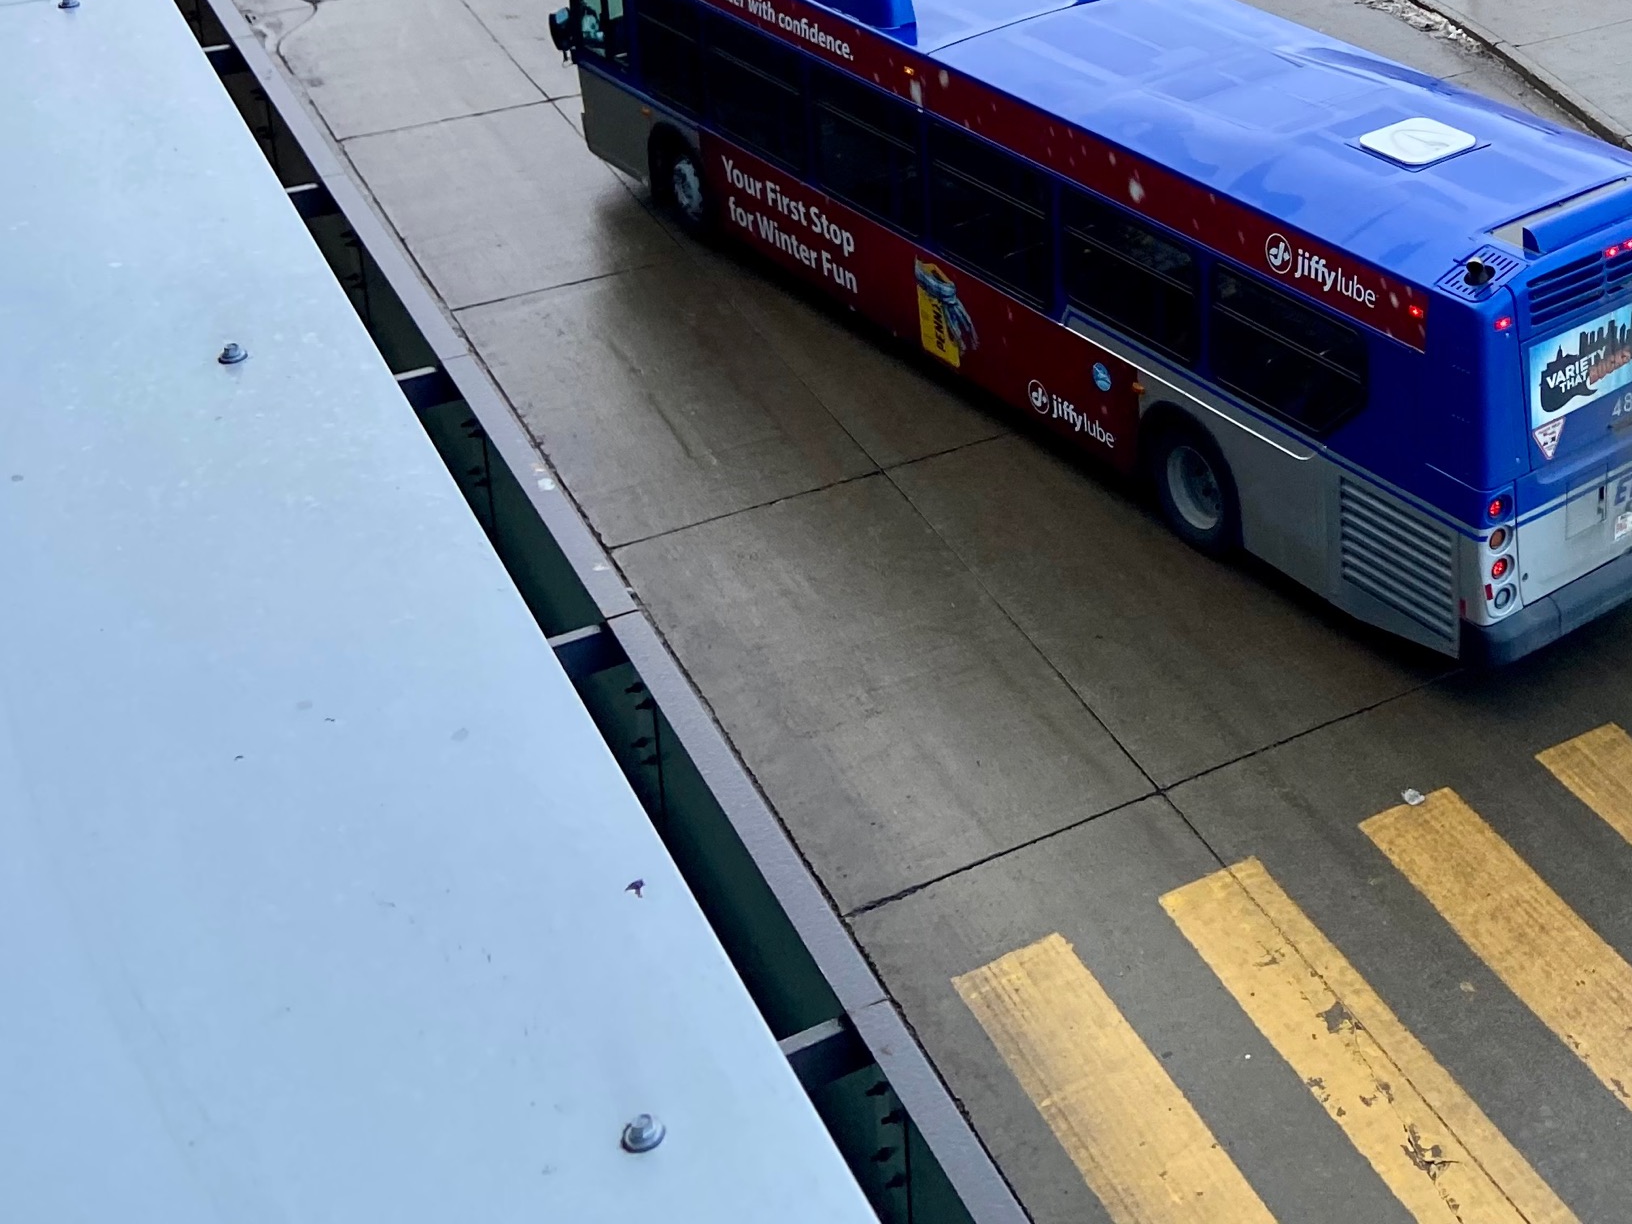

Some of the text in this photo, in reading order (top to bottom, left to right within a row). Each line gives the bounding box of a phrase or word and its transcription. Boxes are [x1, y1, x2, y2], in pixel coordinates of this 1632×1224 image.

[778, 12, 854, 61] confidence.
[721, 154, 855, 257] Your First Stop
[728, 196, 858, 294] for Winter Fun
[1546, 346, 1606, 389] VARIETY
[1559, 370, 1588, 393] THAT
